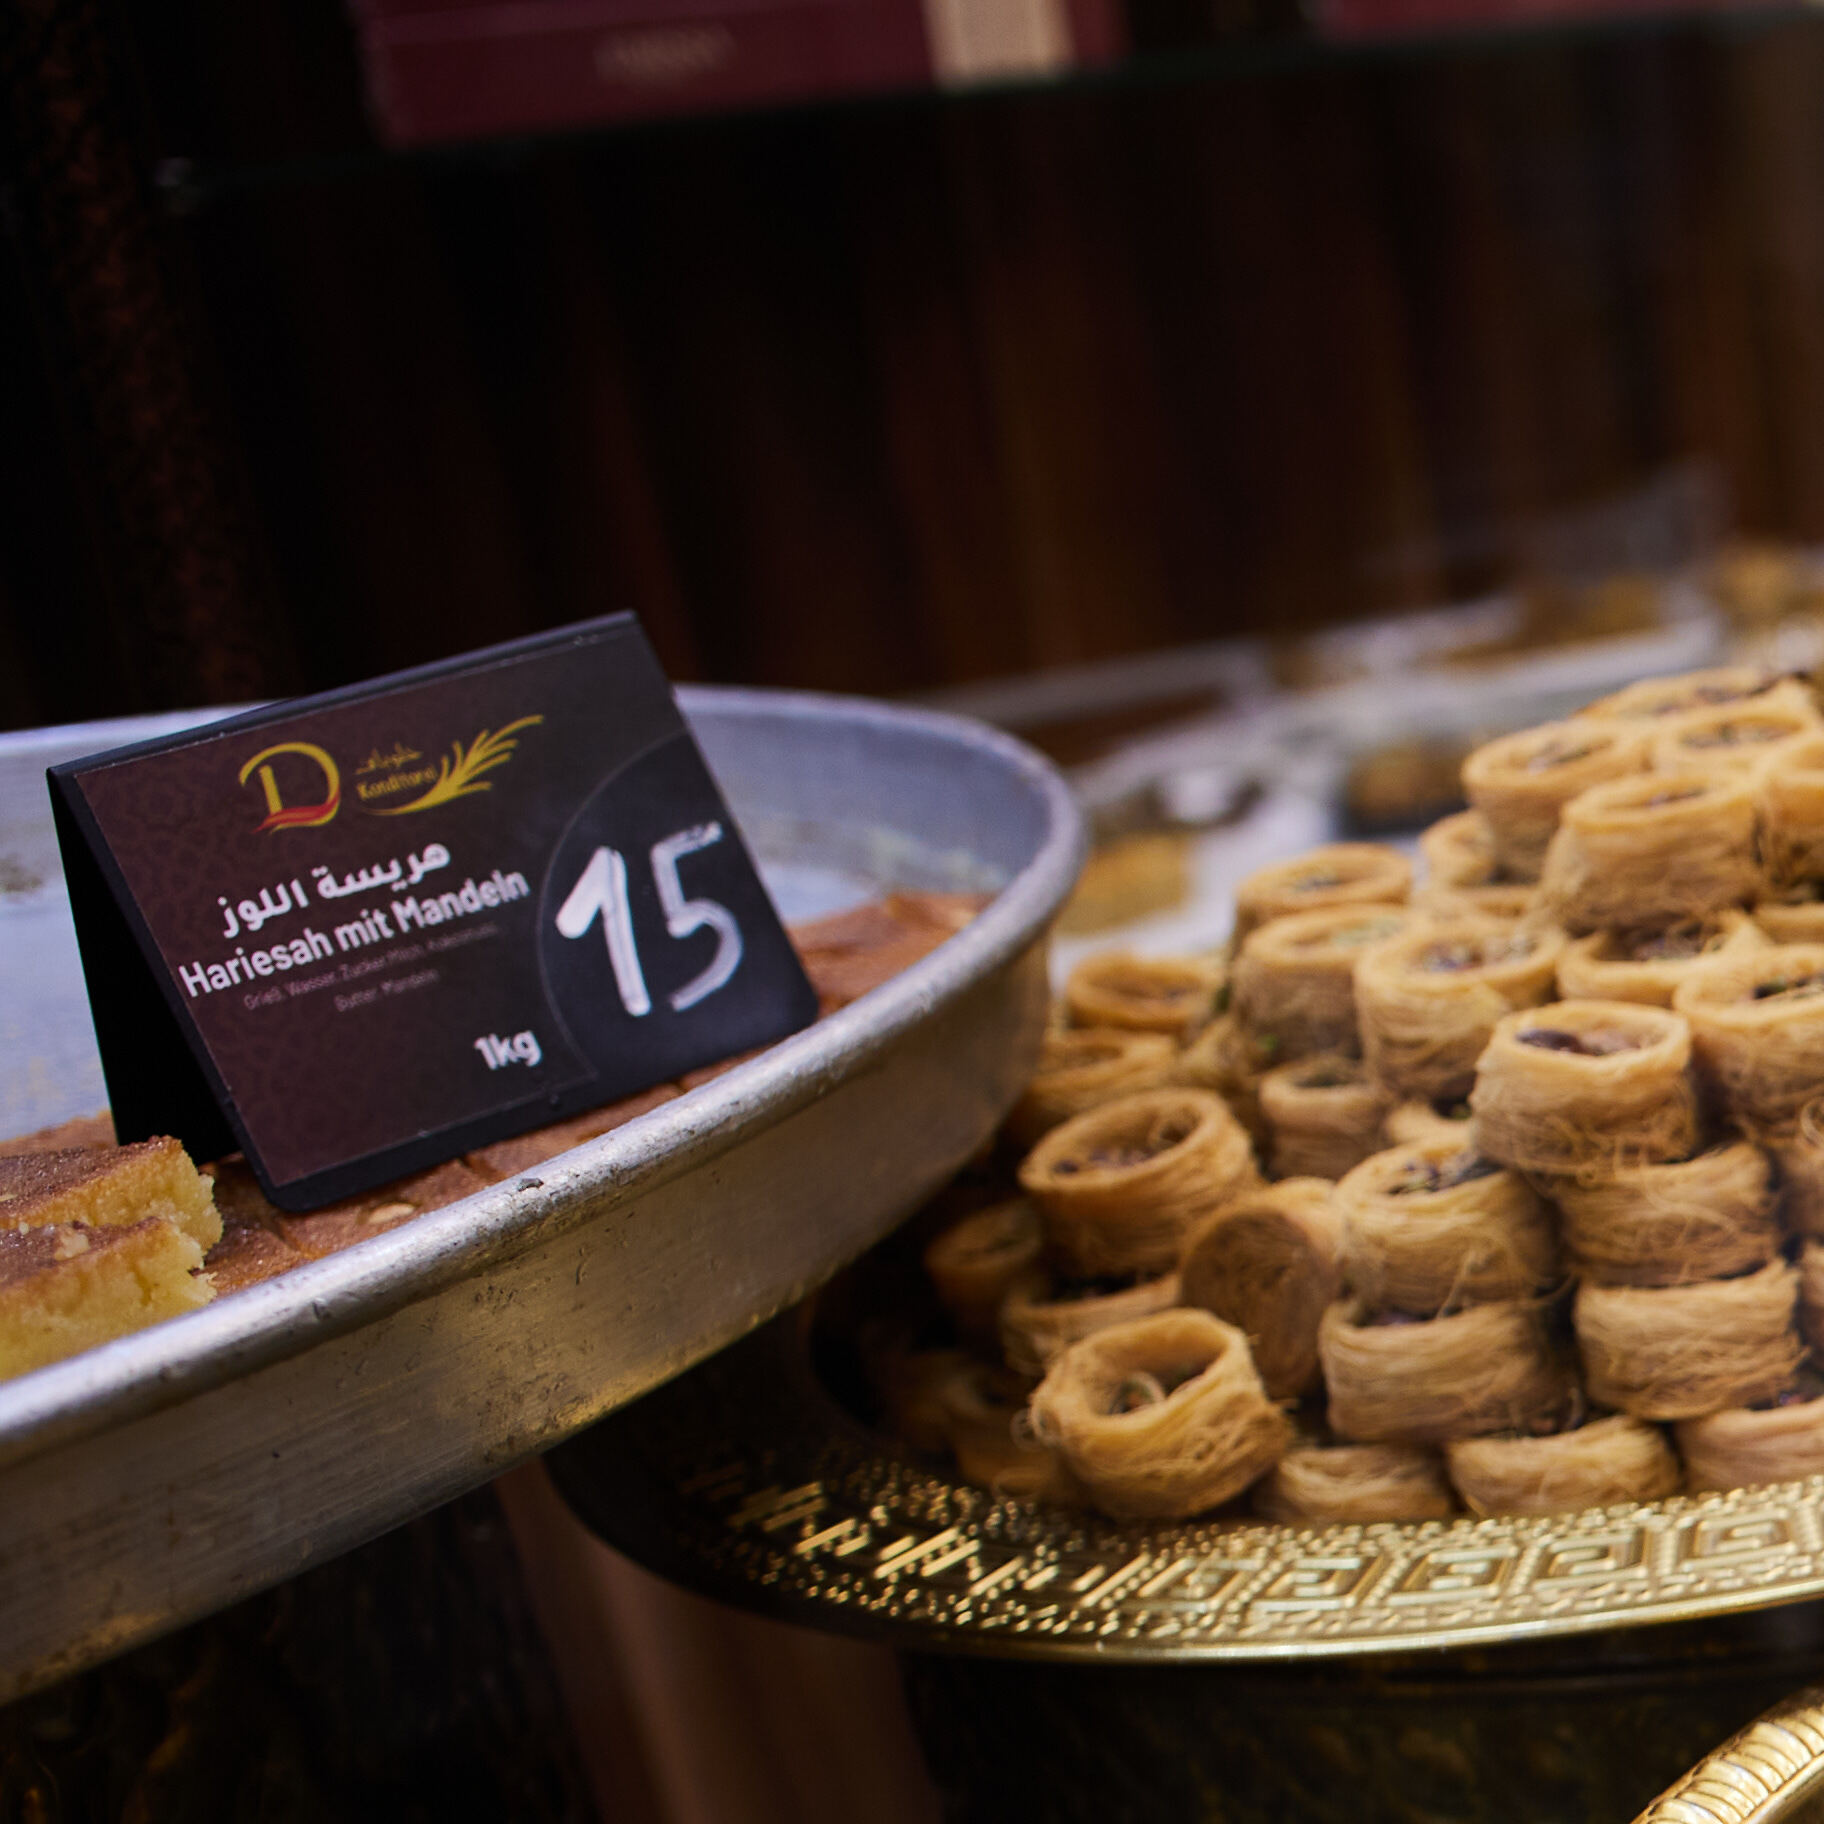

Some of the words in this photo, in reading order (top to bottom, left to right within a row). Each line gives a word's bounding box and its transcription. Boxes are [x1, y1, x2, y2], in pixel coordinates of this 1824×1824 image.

[311, 843, 451, 899] هريسة
[178, 927, 335, 999] Hariesah
[333, 908, 395, 952] mit
[391, 869, 531, 934] Mandeln
[217, 878, 310, 939] اللوز
[555, 820, 744, 1017] 15
[474, 1030, 542, 1071] 1kg
